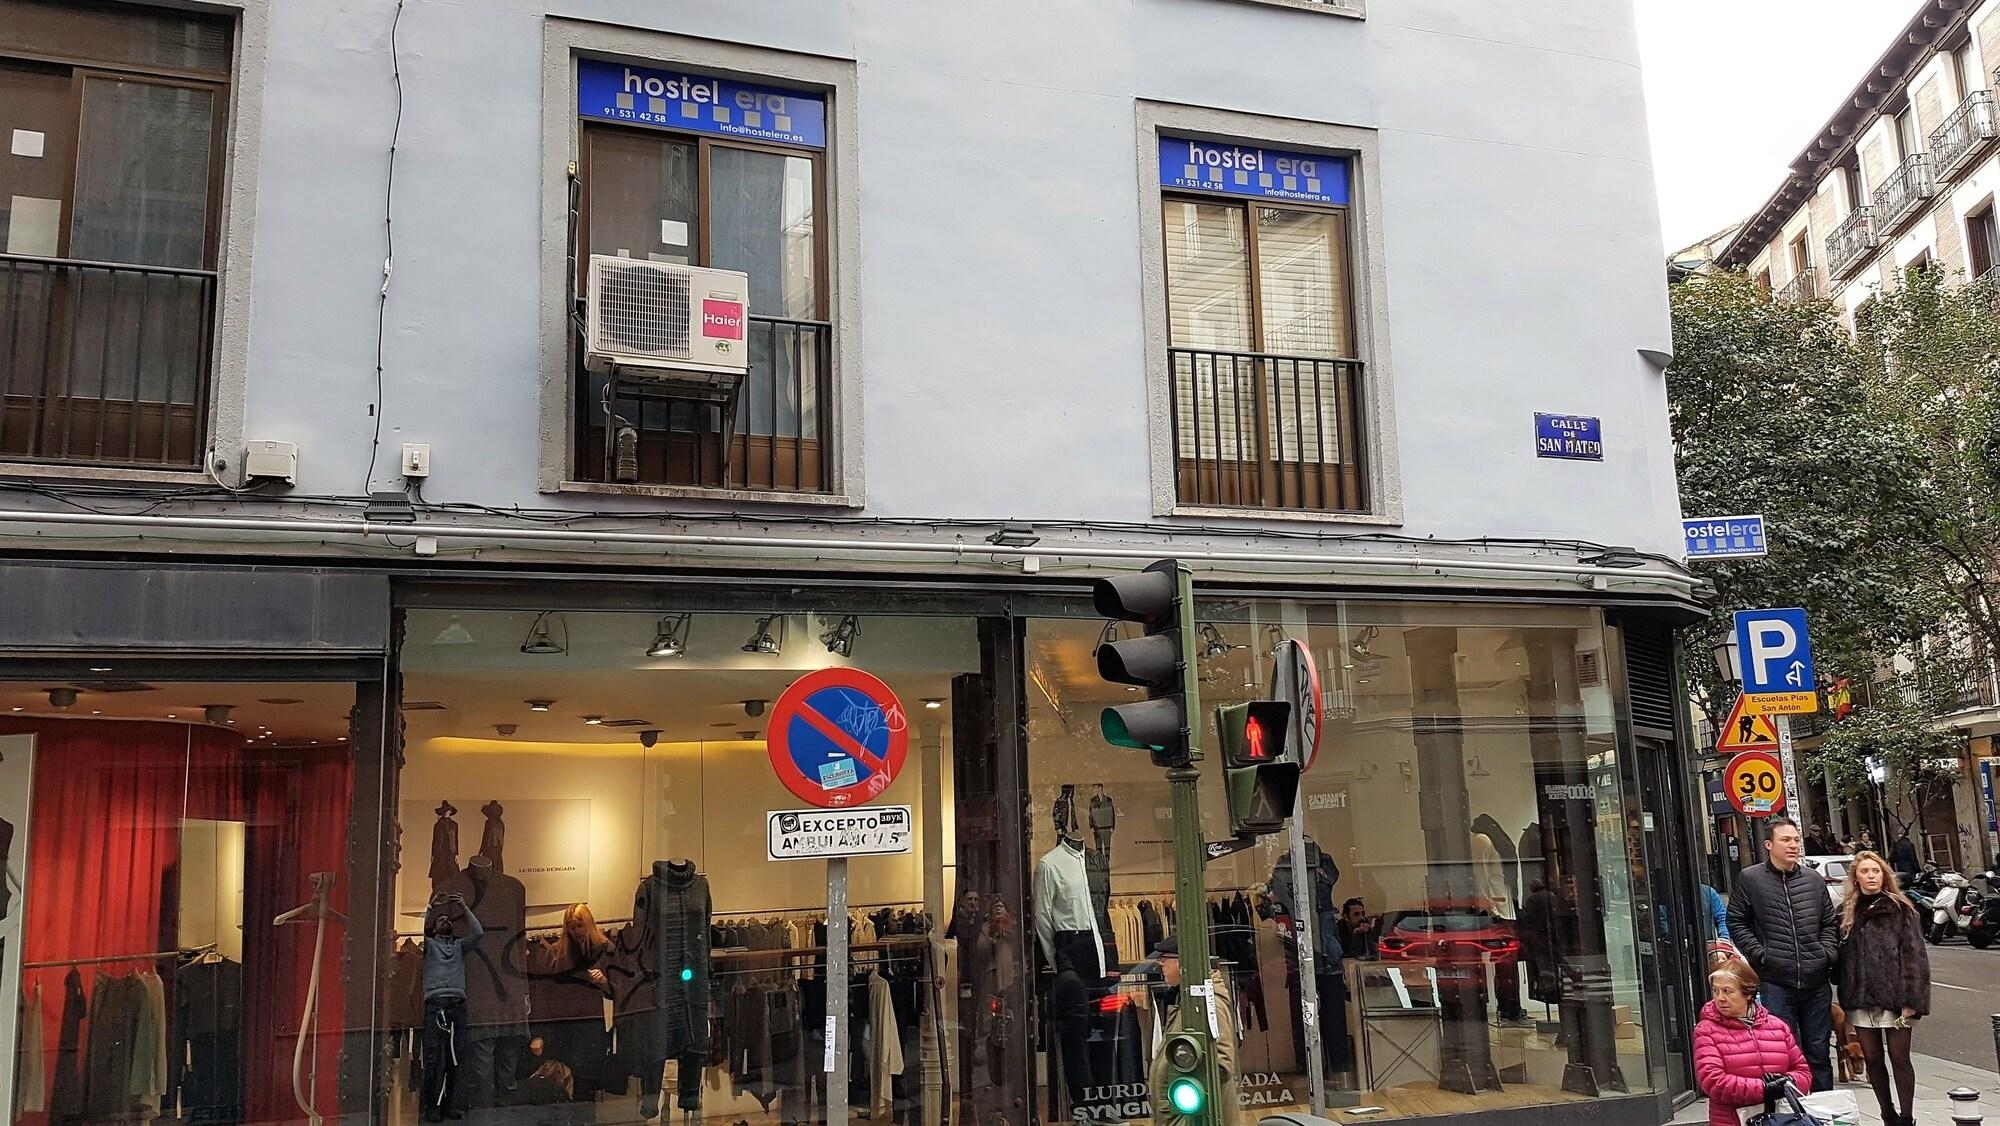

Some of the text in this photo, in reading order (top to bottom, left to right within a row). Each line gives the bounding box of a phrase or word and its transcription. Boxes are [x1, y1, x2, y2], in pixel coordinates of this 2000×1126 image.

[624, 67, 786, 115] hostel era
[604, 107, 666, 123] 91 531 42 58
[1189, 141, 1316, 178] hostel era
[1175, 178, 1223, 190] 91 531 42 58
[704, 313, 741, 327] Haier
[1551, 419, 1588, 431] CALLE
[1563, 430, 1576, 438] DE
[1540, 437, 1600, 455] SAN MATEO
[1685, 521, 1760, 538] ostelera
[1748, 619, 1797, 685] P
[1752, 695, 1788, 703] Escuelas
[1761, 704, 1777, 712] San
[1739, 771, 1776, 794] 30
[803, 817, 877, 833] EXCEPTO
[1083, 1082, 1151, 1101] LURD
[1073, 1088, 1294, 1120] SYNGM CALA
